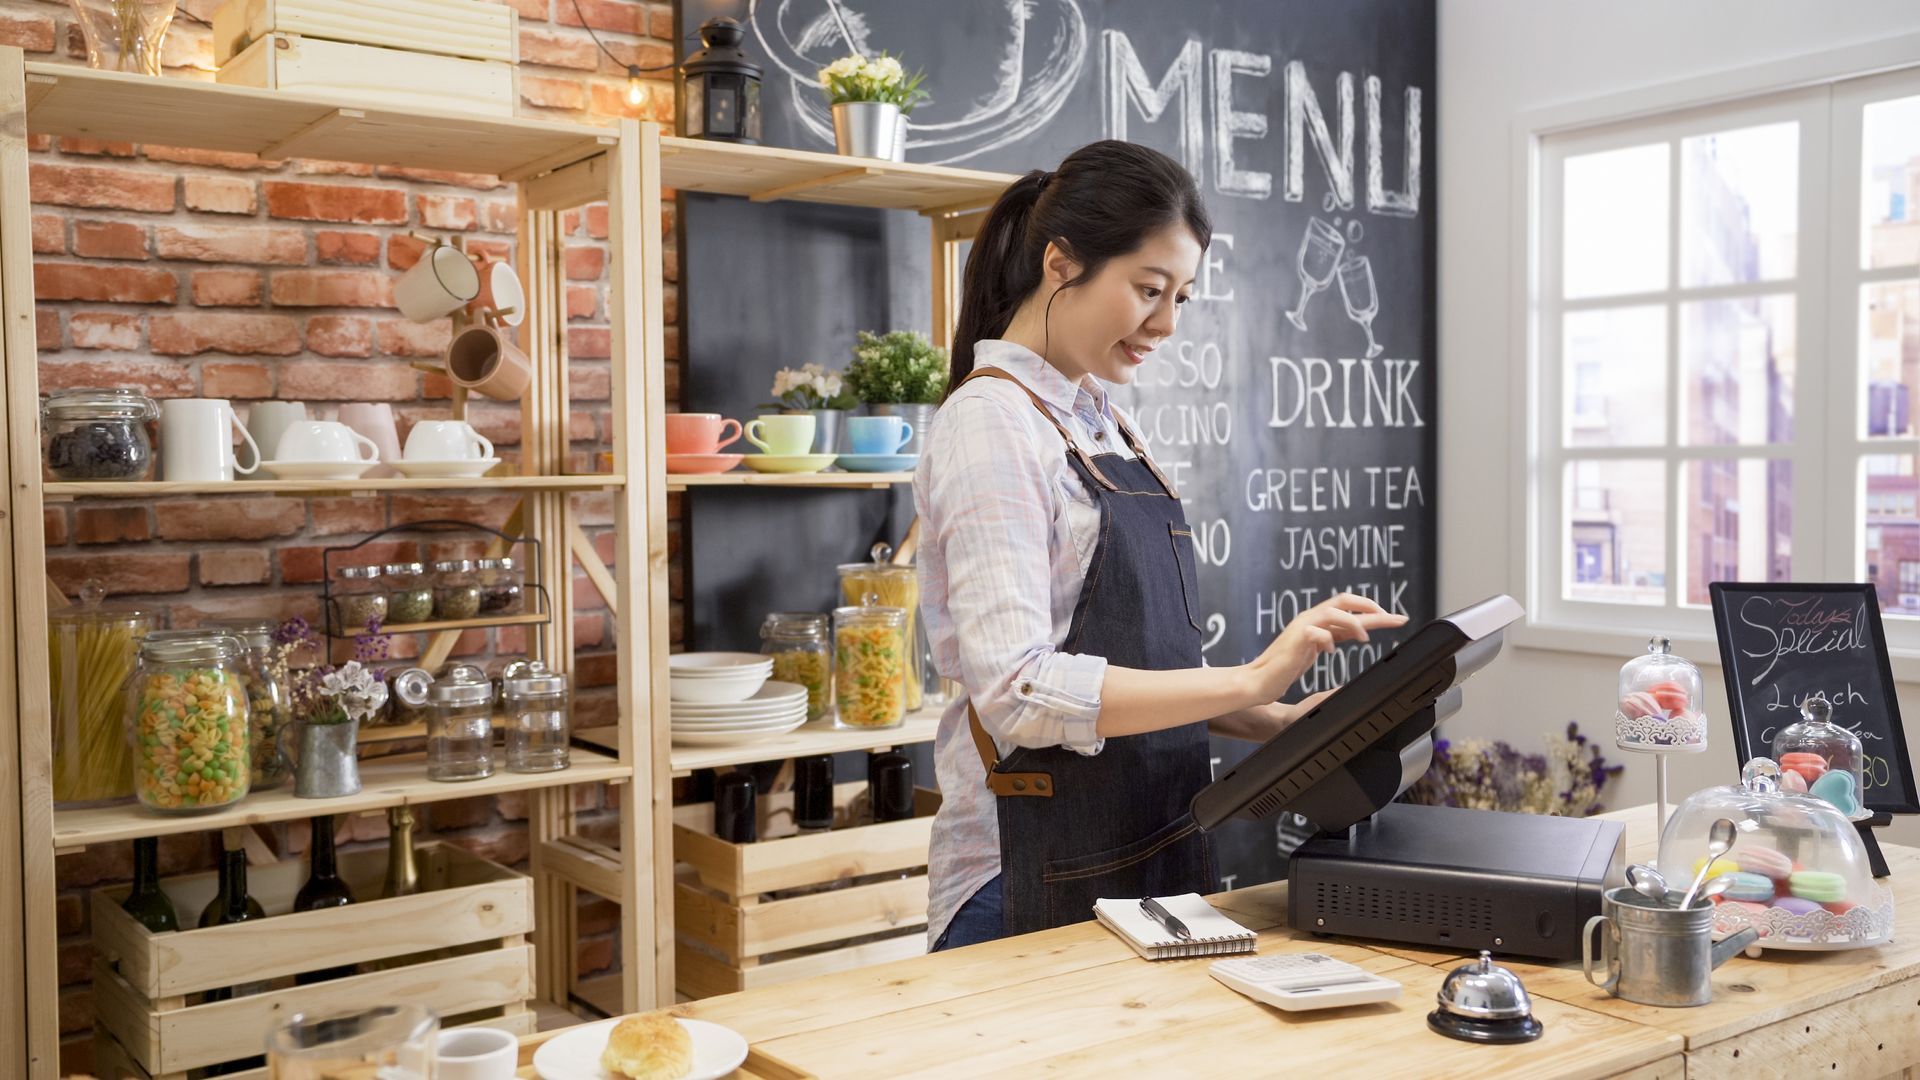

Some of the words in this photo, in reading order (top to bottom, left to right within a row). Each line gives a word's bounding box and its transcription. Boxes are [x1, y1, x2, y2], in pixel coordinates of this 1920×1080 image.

[1101, 28, 1421, 217] MENU
[1268, 357, 1425, 427] DRINK
[1128, 402, 1231, 446] CCINO
[1246, 468, 1350, 511] GREEN
[1364, 466, 1424, 510] TEA
[1280, 524, 1405, 571] JASMINE
[1256, 588, 1319, 635] HOT
[1741, 595, 1867, 686] Special
[1766, 682, 1869, 711] Lunch
